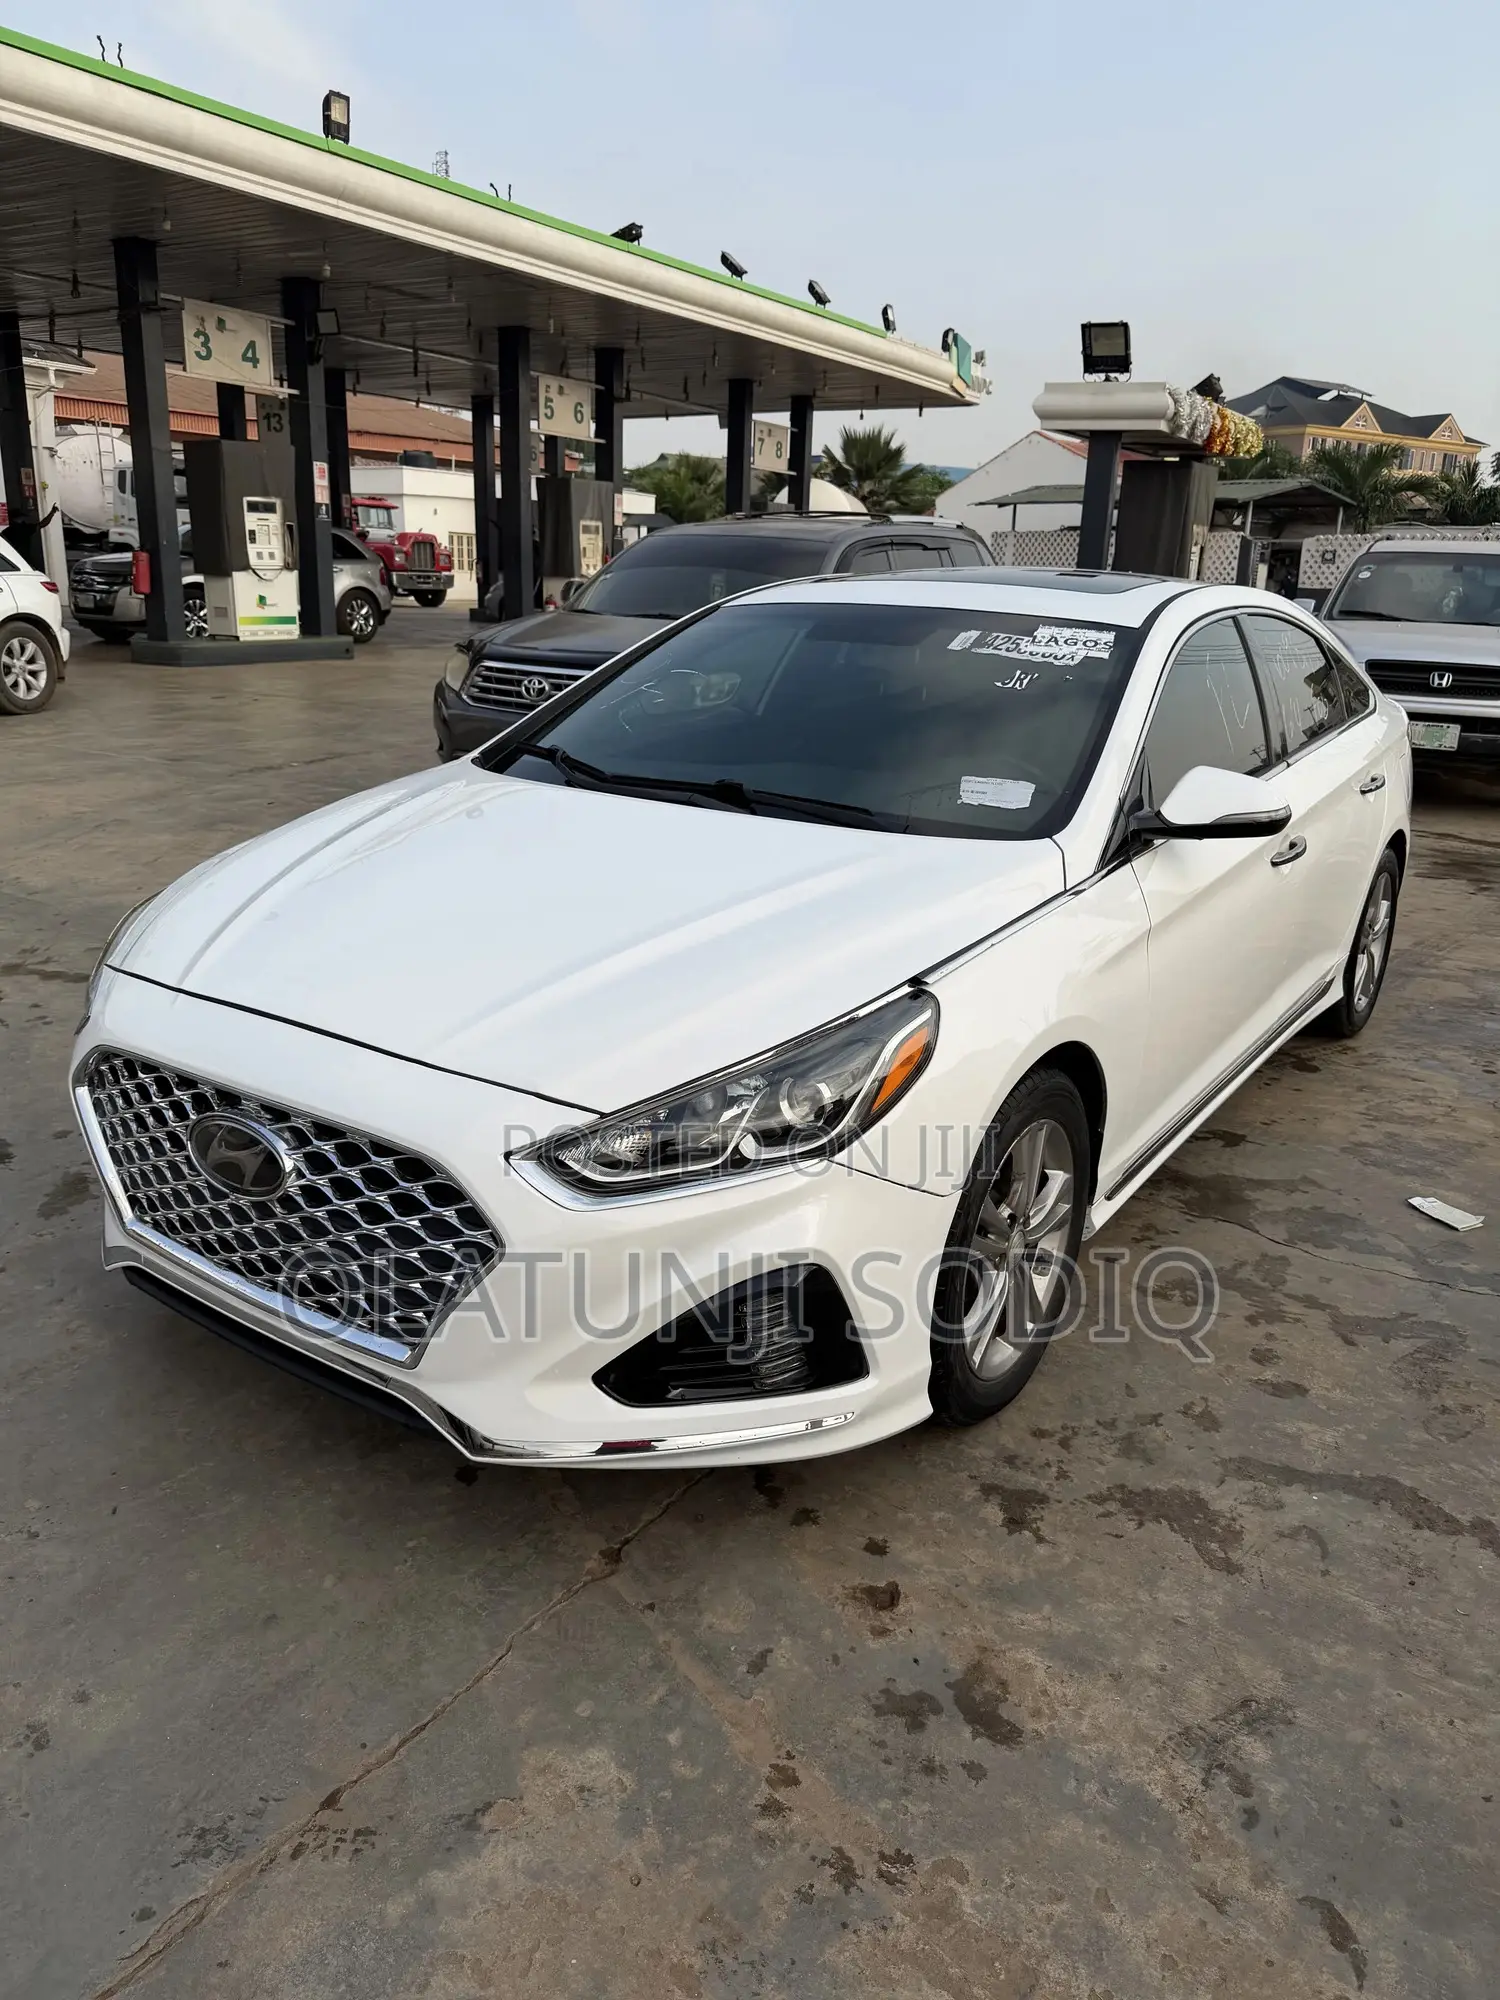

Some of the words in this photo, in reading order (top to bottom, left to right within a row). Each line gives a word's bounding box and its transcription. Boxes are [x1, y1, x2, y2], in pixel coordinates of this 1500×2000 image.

[193, 328, 212, 361] 3
[241, 340, 260, 369] 4
[544, 395, 554, 420] 5
[574, 402, 584, 424] 6
[263, 412, 284, 433] 13
[757, 437, 765, 456] 7
[776, 441, 783, 459] 8
[1031, 633, 1113, 650] LAGOS
